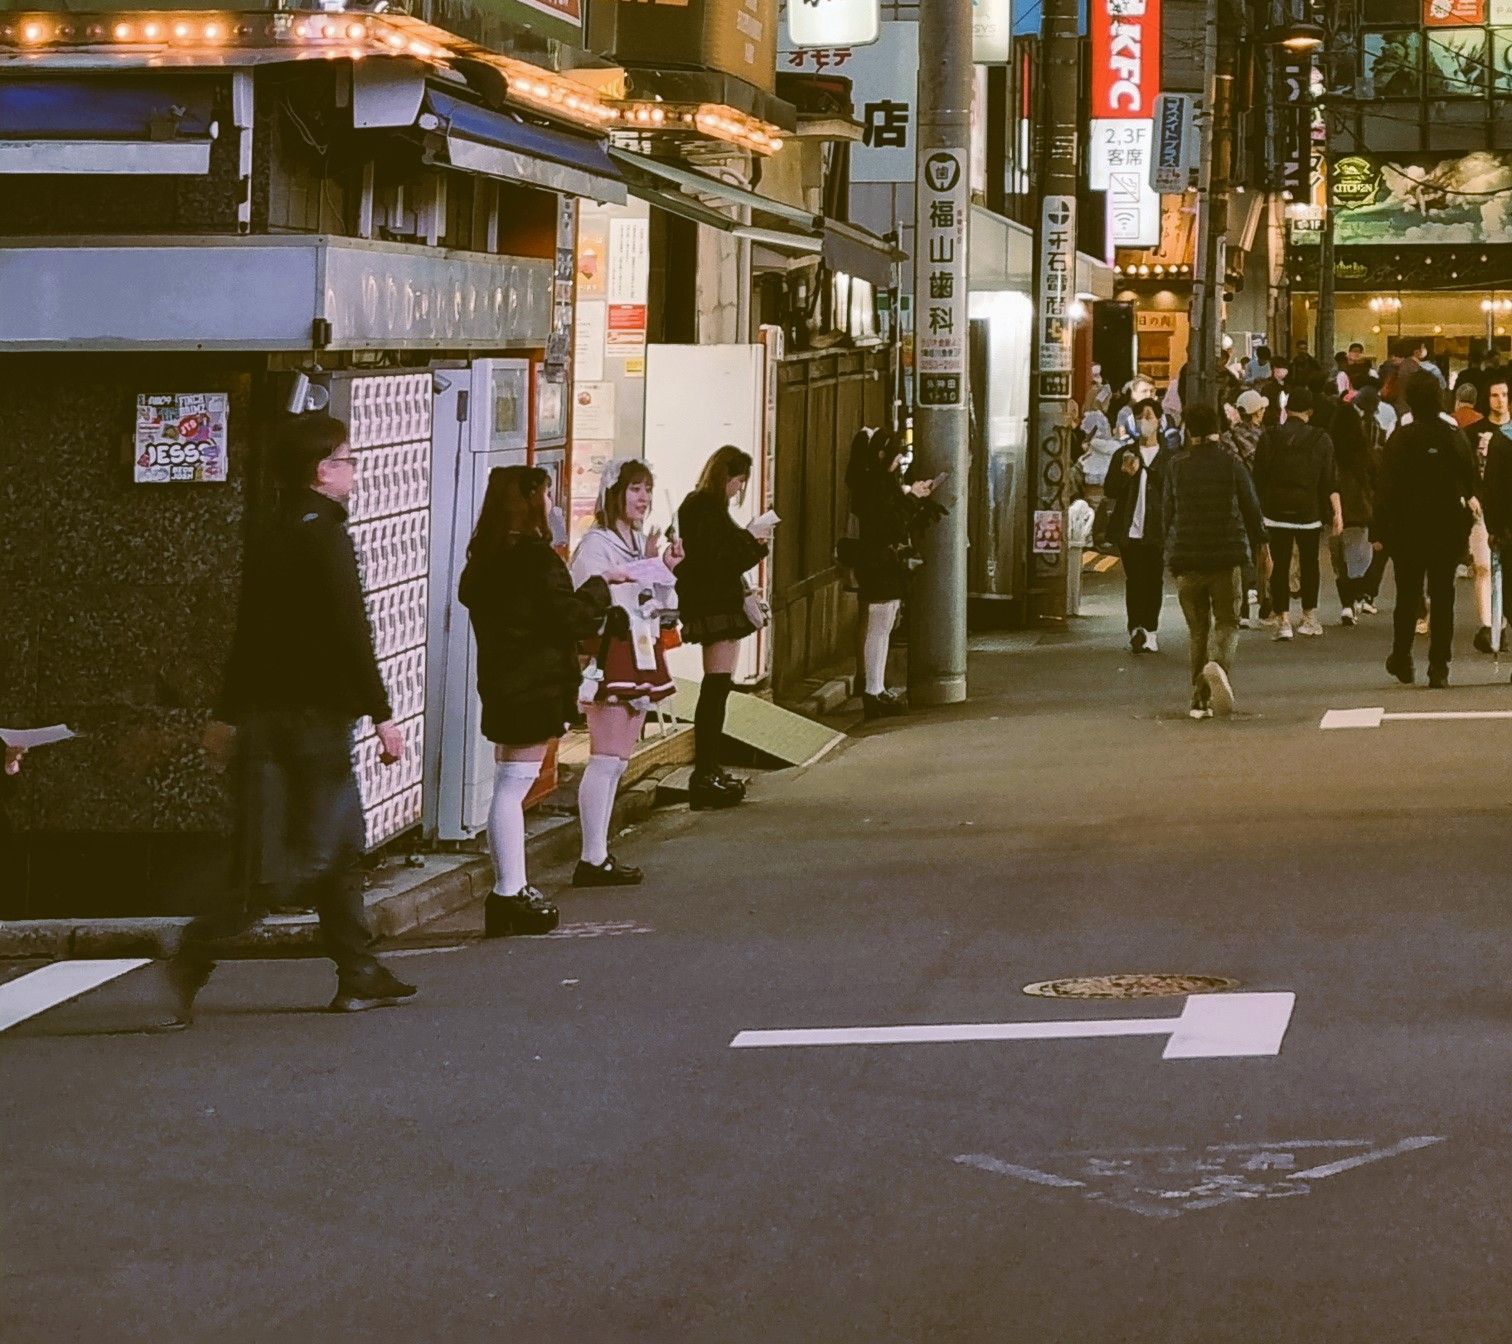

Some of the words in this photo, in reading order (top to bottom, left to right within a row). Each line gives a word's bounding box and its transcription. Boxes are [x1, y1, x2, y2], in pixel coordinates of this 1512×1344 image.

[1108, 24, 1143, 112] KFC
[863, 99, 909, 148] 店
[1107, 148, 1144, 166] 客席
[928, 200, 955, 336] 福山歯科
